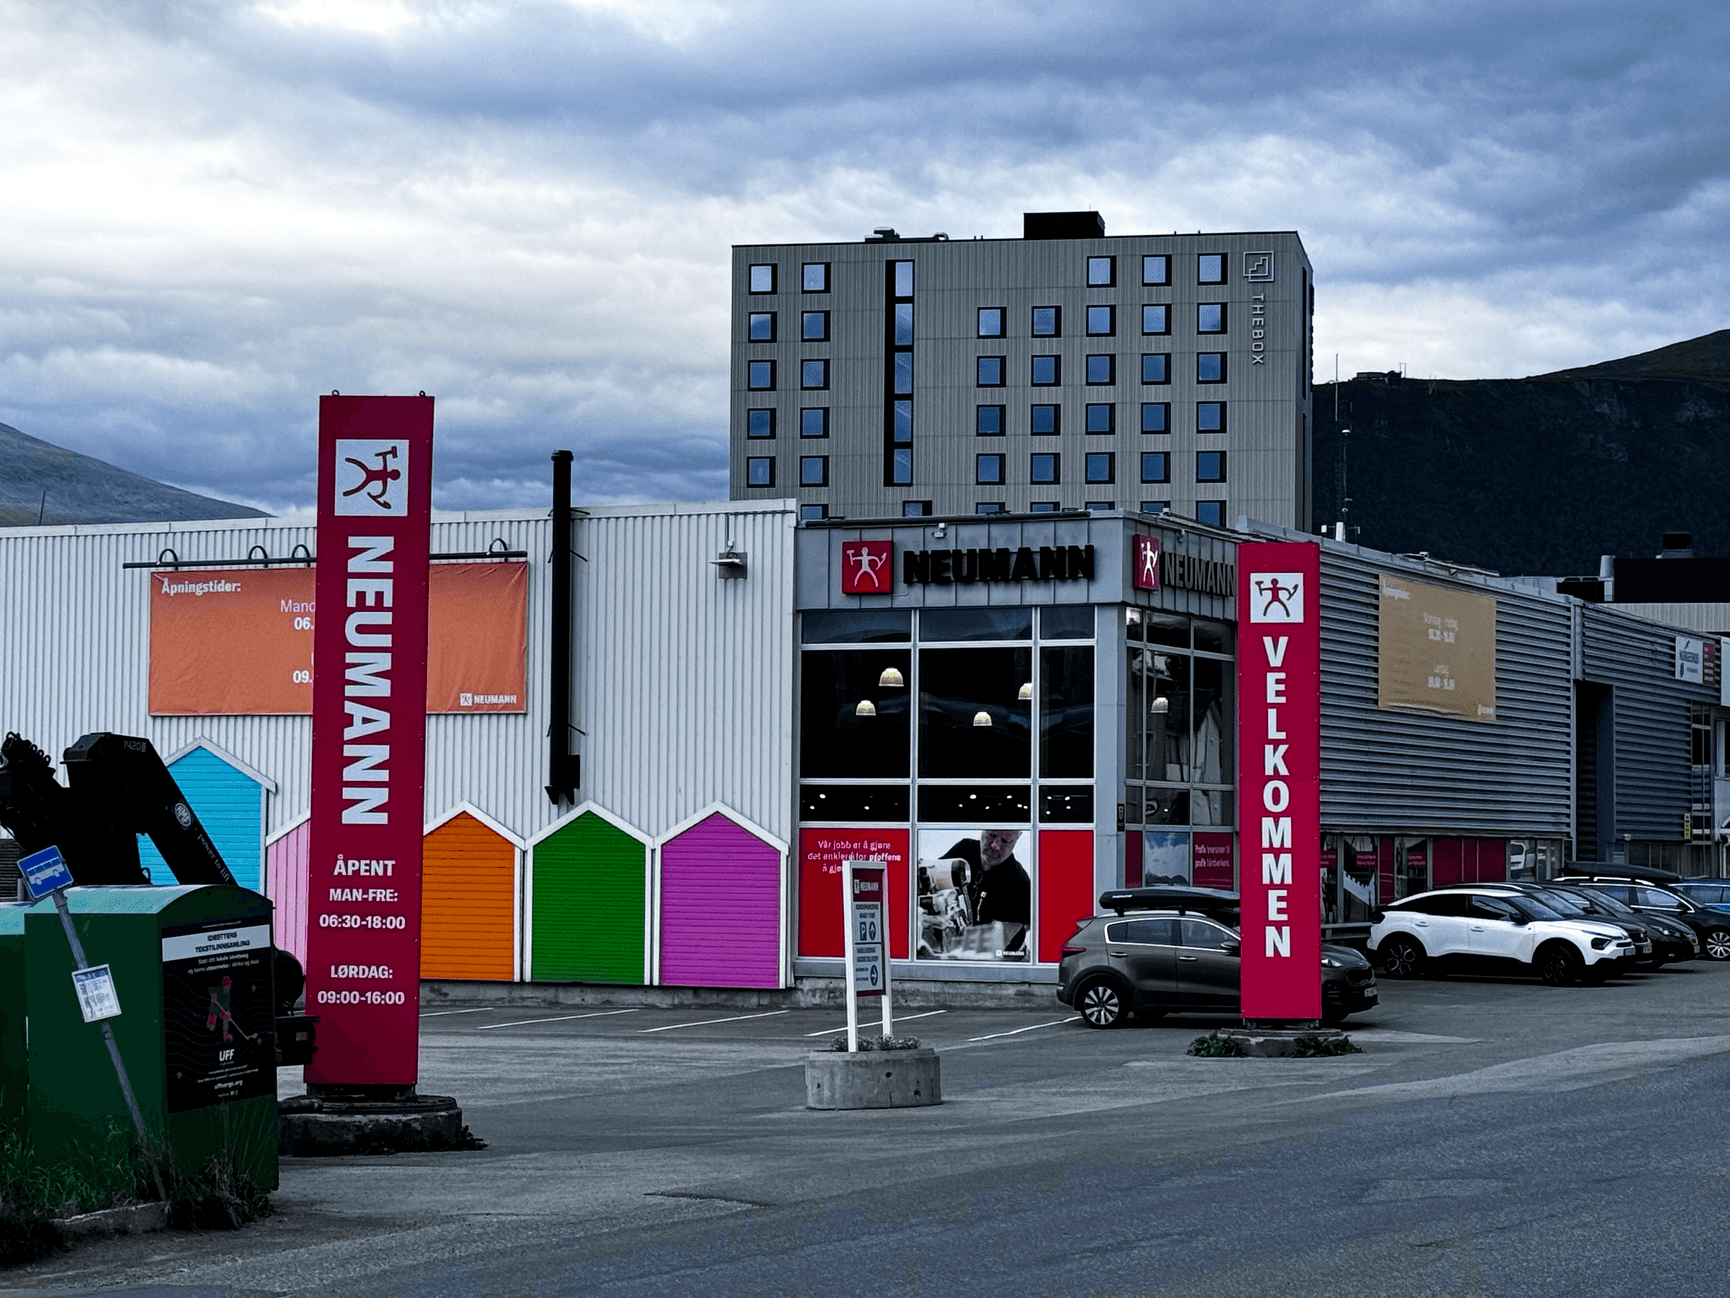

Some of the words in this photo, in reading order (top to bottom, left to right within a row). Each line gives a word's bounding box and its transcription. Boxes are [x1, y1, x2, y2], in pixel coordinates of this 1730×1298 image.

[903, 545, 1095, 584] NEUMANN
[1163, 551, 1236, 597] NEUMANN
[161, 577, 241, 596] Åpningstider:
[294, 617, 315, 630] 06.
[292, 670, 313, 683] 09.
[341, 536, 395, 825] NEUMANN
[473, 694, 517, 704] NEUMANN
[1261, 636, 1293, 958] VELKOMMEN
[818, 839, 832, 849] Vår
[833, 840, 851, 850] jobb
[863, 839, 868, 849] å
[870, 841, 891, 851] gjøre
[807, 852, 821, 860] det
[333, 854, 396, 876] ÅPENT
[829, 864, 842, 874] gjø
[329, 888, 399, 902] MAN-FRE:
[319, 914, 406, 929] 06:30-18:00
[330, 965, 393, 979] LØRDAG:
[317, 991, 405, 1004] 09:00-16:00
[219, 1049, 235, 1061] UFF
